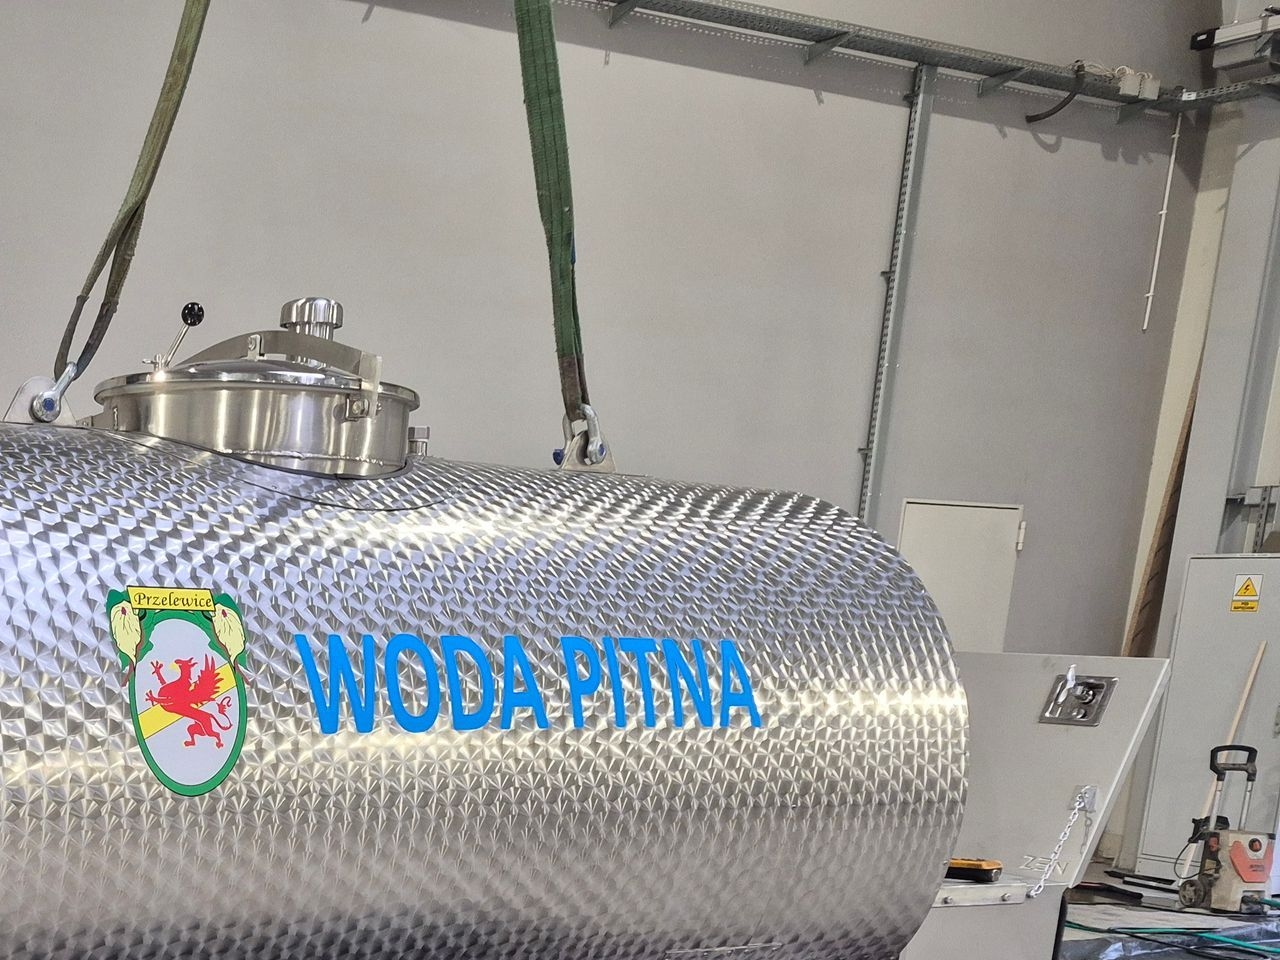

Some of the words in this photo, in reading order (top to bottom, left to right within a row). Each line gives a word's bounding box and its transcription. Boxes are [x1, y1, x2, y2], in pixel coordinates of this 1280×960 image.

[133, 592, 212, 607] Przelewice
[295, 633, 549, 734] WODA
[561, 636, 762, 728] PITNA
